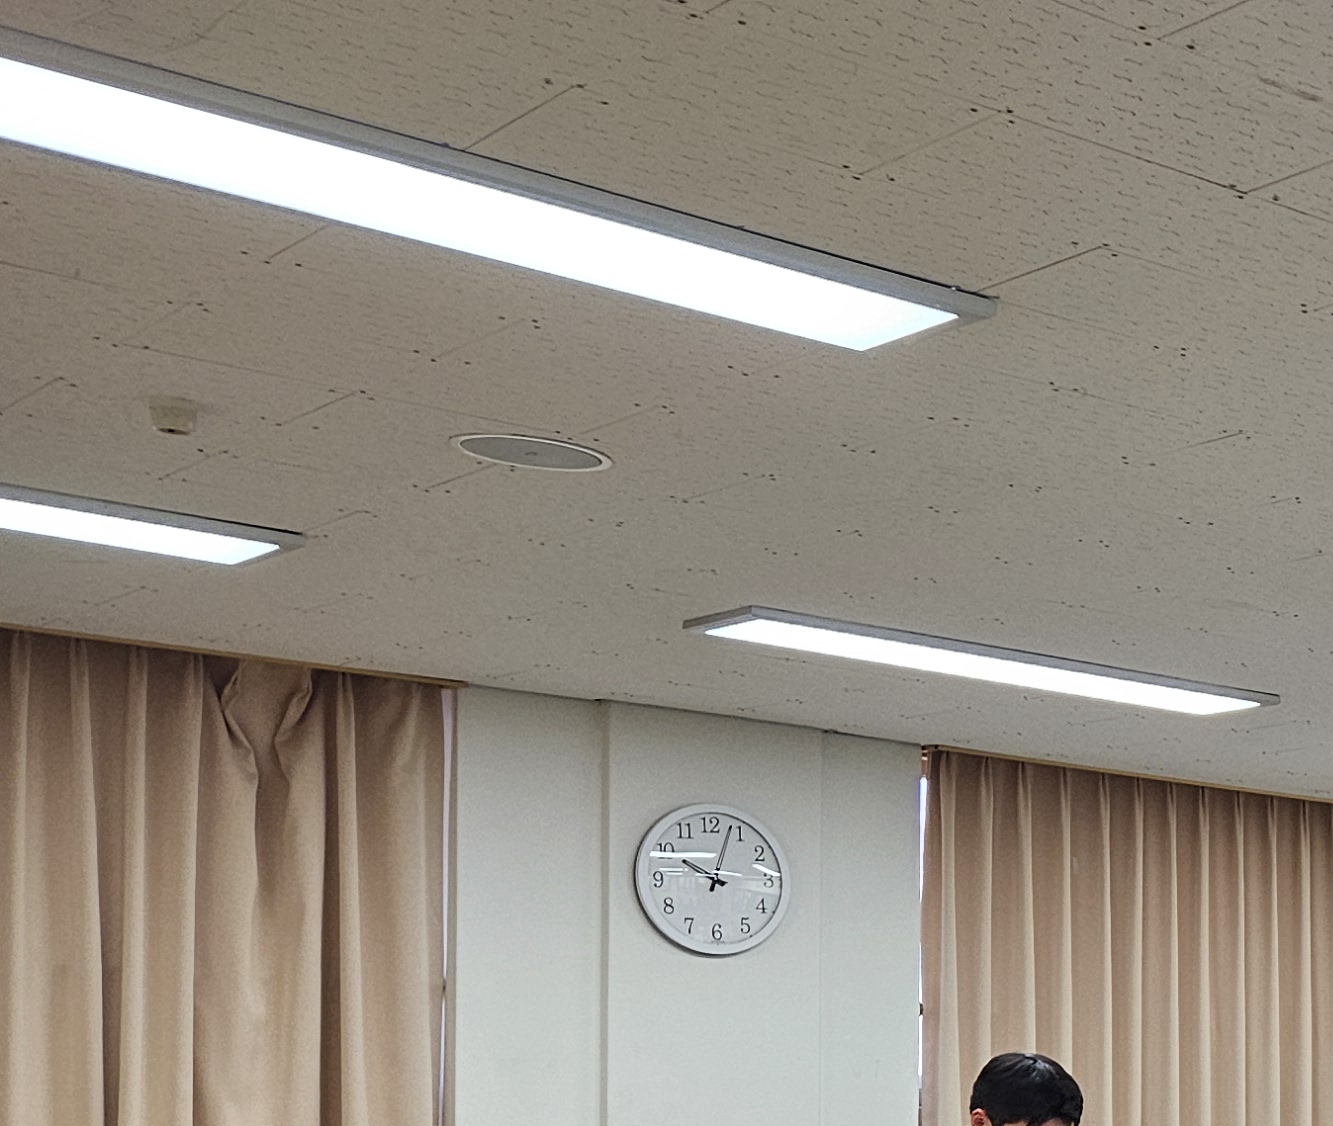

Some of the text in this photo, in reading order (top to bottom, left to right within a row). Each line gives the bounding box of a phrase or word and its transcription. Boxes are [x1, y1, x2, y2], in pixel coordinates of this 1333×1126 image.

[677, 823, 694, 839] 11
[700, 816, 720, 833] 12
[736, 826, 744, 842] 1
[754, 845, 765, 862] 2
[653, 871, 664, 888] 9
[764, 873, 774, 888] 3
[663, 897, 675, 914] 8
[756, 898, 768, 914] 4
[684, 917, 694, 934] 7
[711, 923, 723, 941] 6
[740, 917, 751, 933] 5
